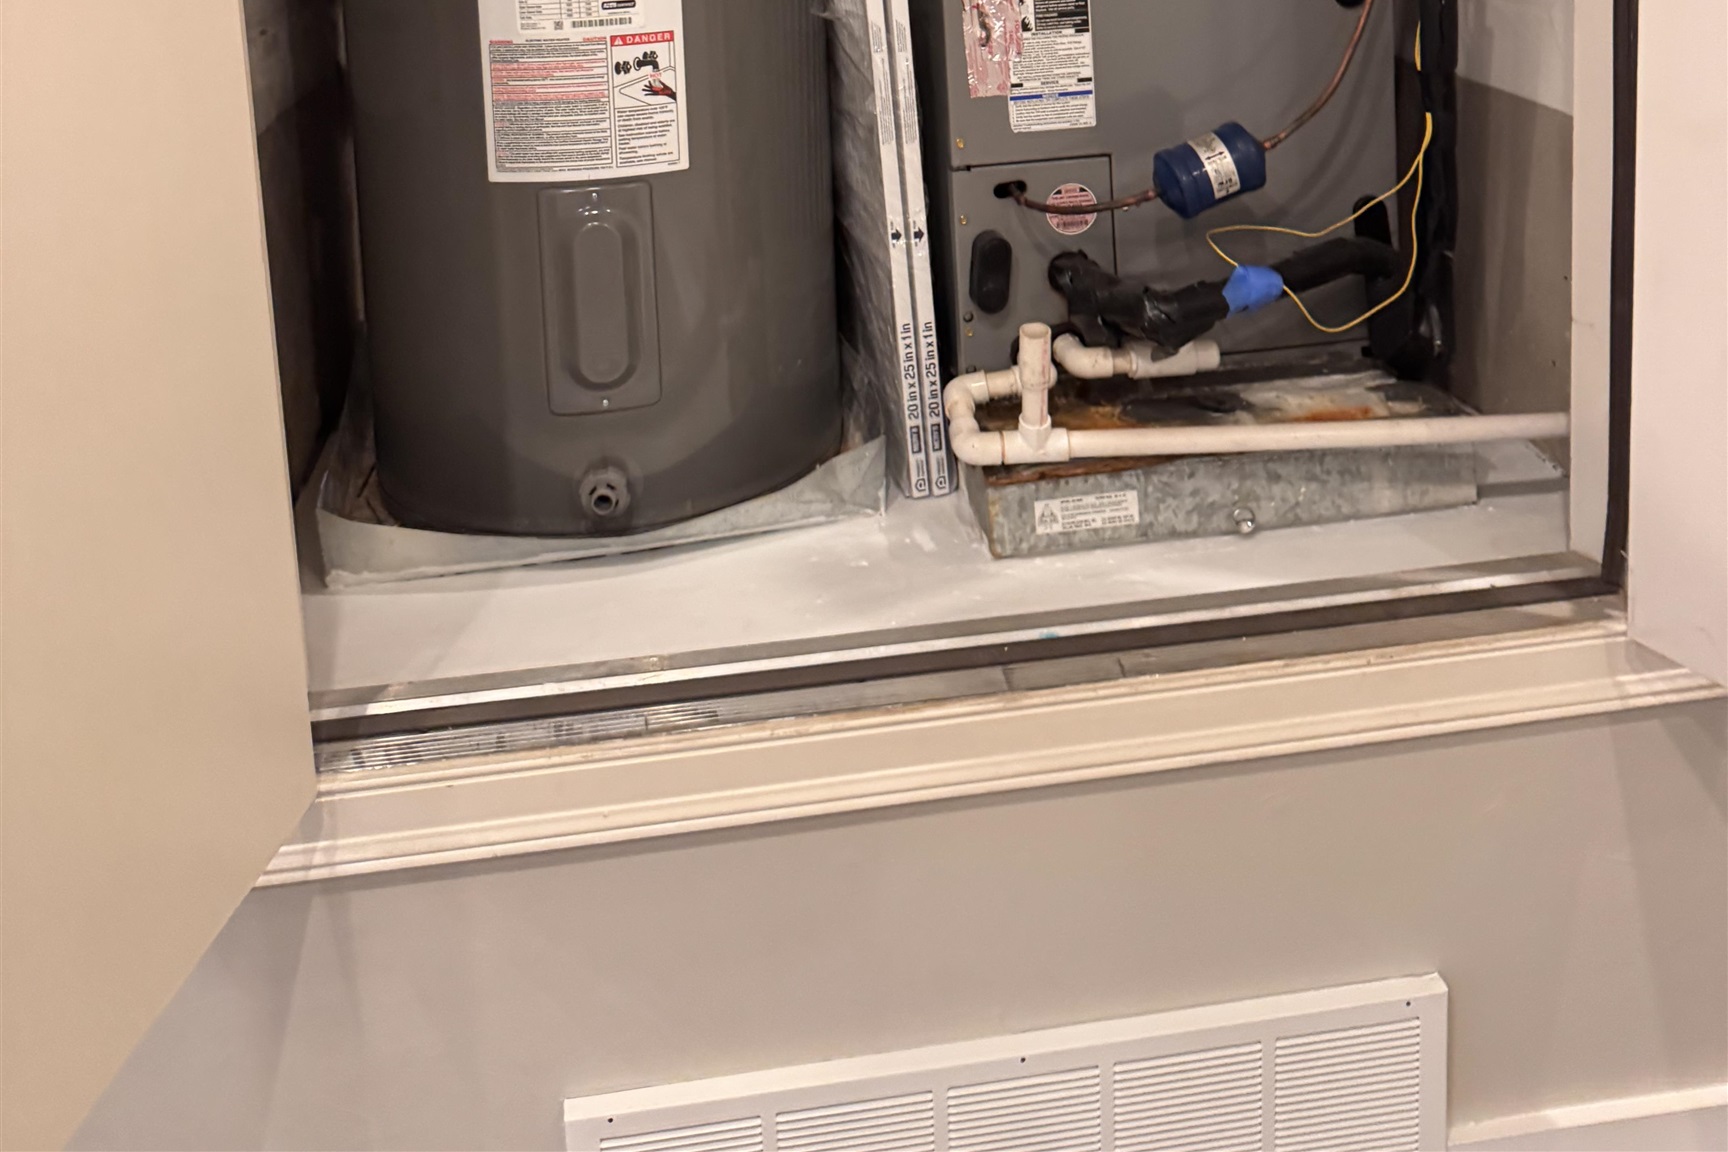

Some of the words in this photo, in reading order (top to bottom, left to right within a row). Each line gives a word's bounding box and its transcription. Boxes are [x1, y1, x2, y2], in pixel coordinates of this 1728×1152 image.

[626, 32, 671, 44] DANGER
[900, 323, 911, 334] in
[922, 322, 933, 332] in
[904, 351, 914, 363] in
[925, 350, 935, 361] in
[904, 364, 915, 380] 25
[925, 363, 936, 378] 25
[929, 379, 937, 387] x
[907, 391, 917, 402] in
[928, 389, 938, 400] in
[908, 404, 919, 420] 20
[929, 402, 940, 417] 20
